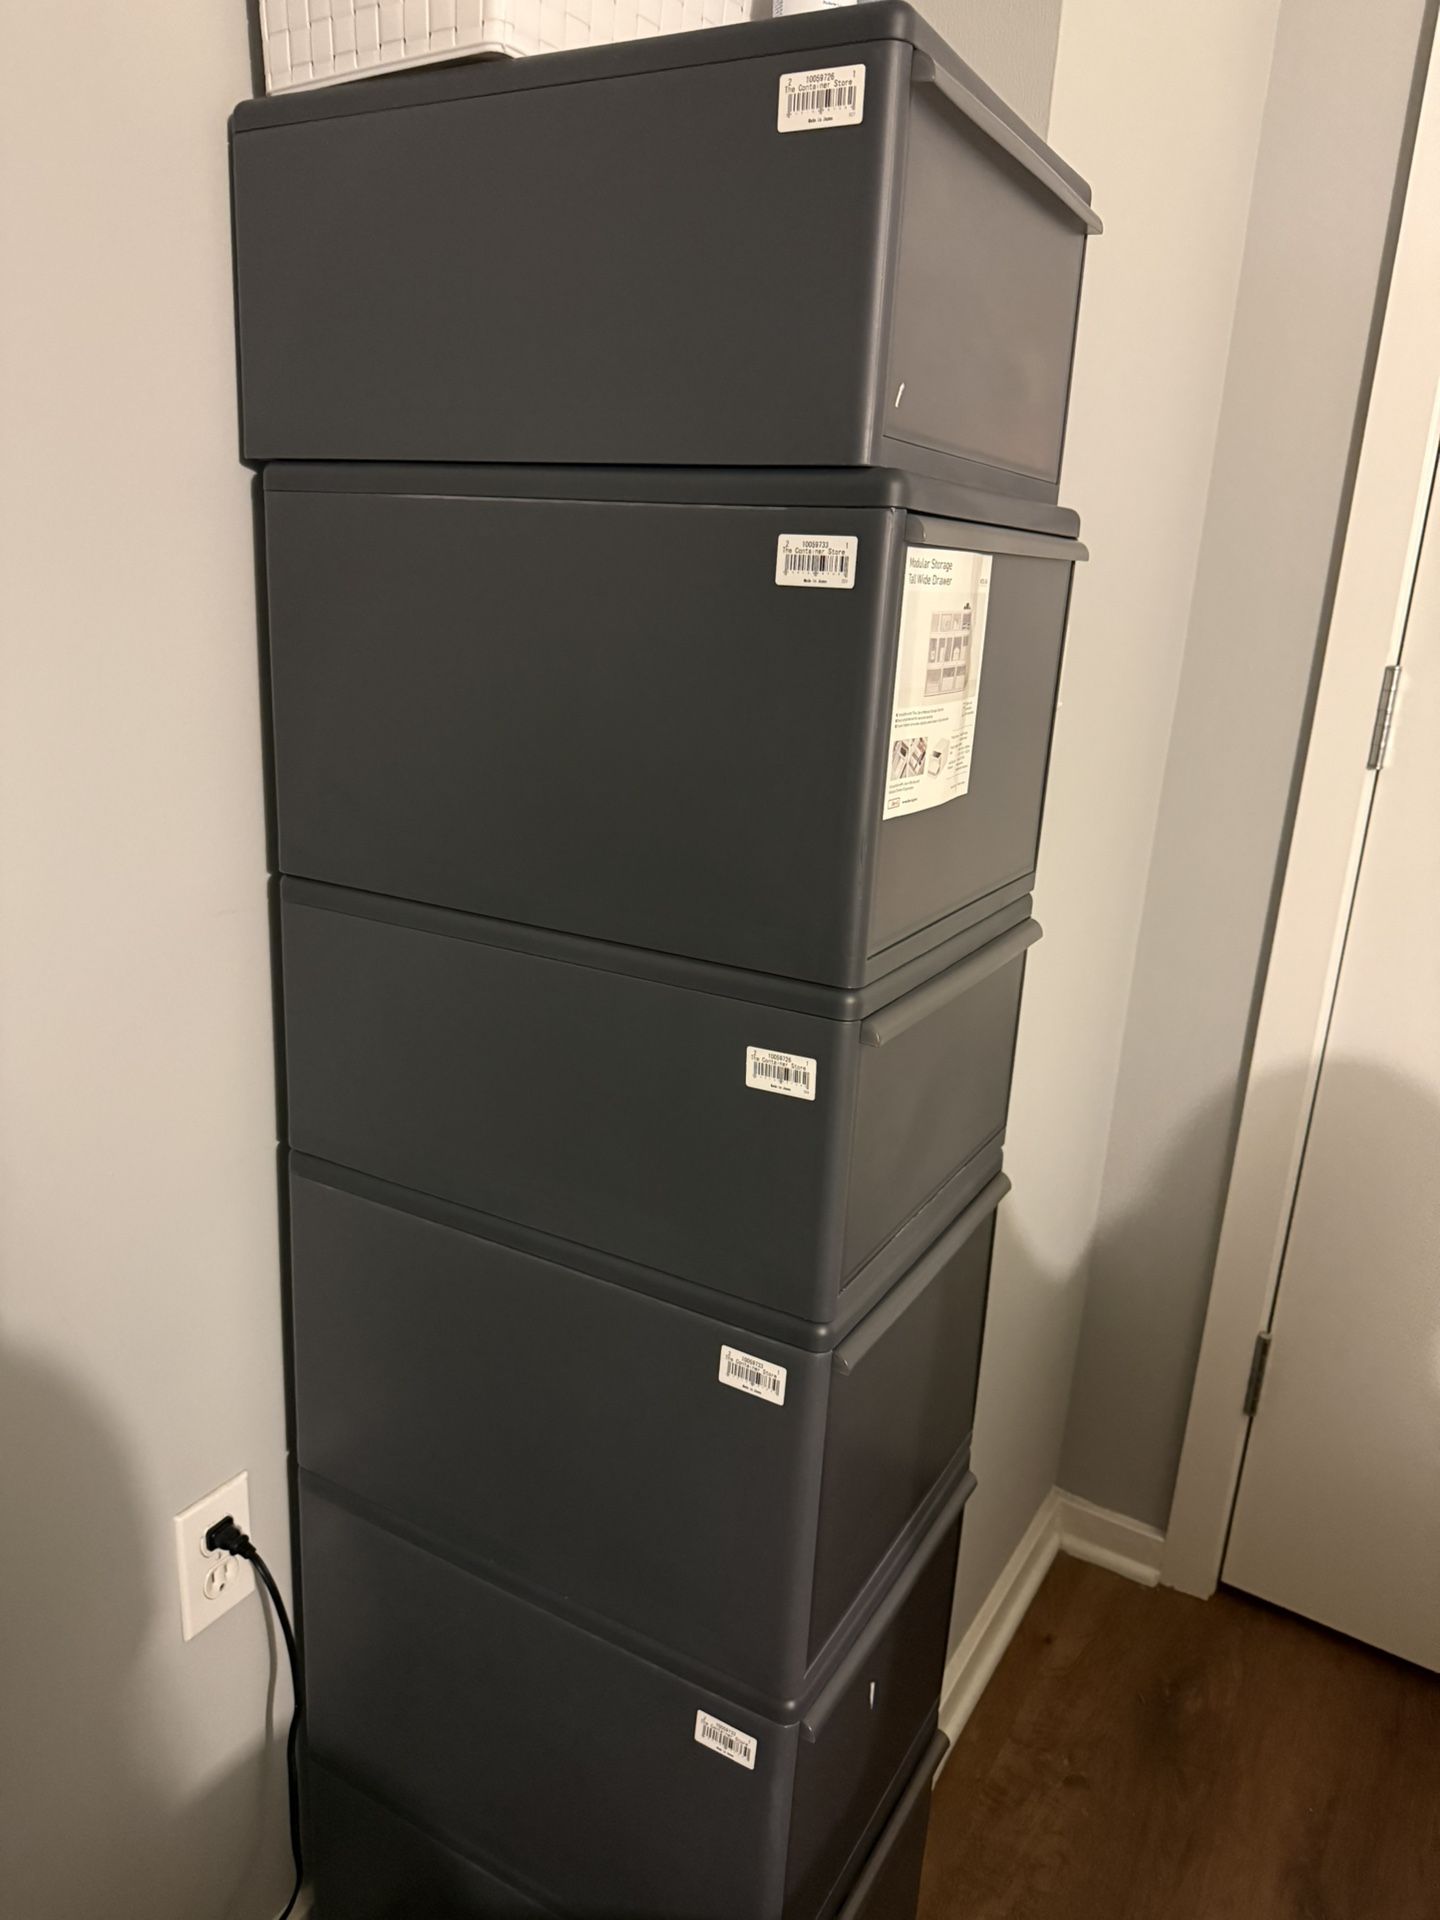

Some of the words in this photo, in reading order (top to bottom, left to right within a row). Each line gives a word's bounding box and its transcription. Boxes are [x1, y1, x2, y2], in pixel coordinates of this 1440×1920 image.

[798, 82, 830, 91] Container
[834, 80, 853, 88] Store
[909, 557, 931, 570] Modular
[931, 559, 953, 572] Storage
[909, 573, 917, 584] Tall
[917, 574, 931, 585] Wide
[932, 575, 953, 585] Drawer
[791, 1062, 806, 1071] Store
